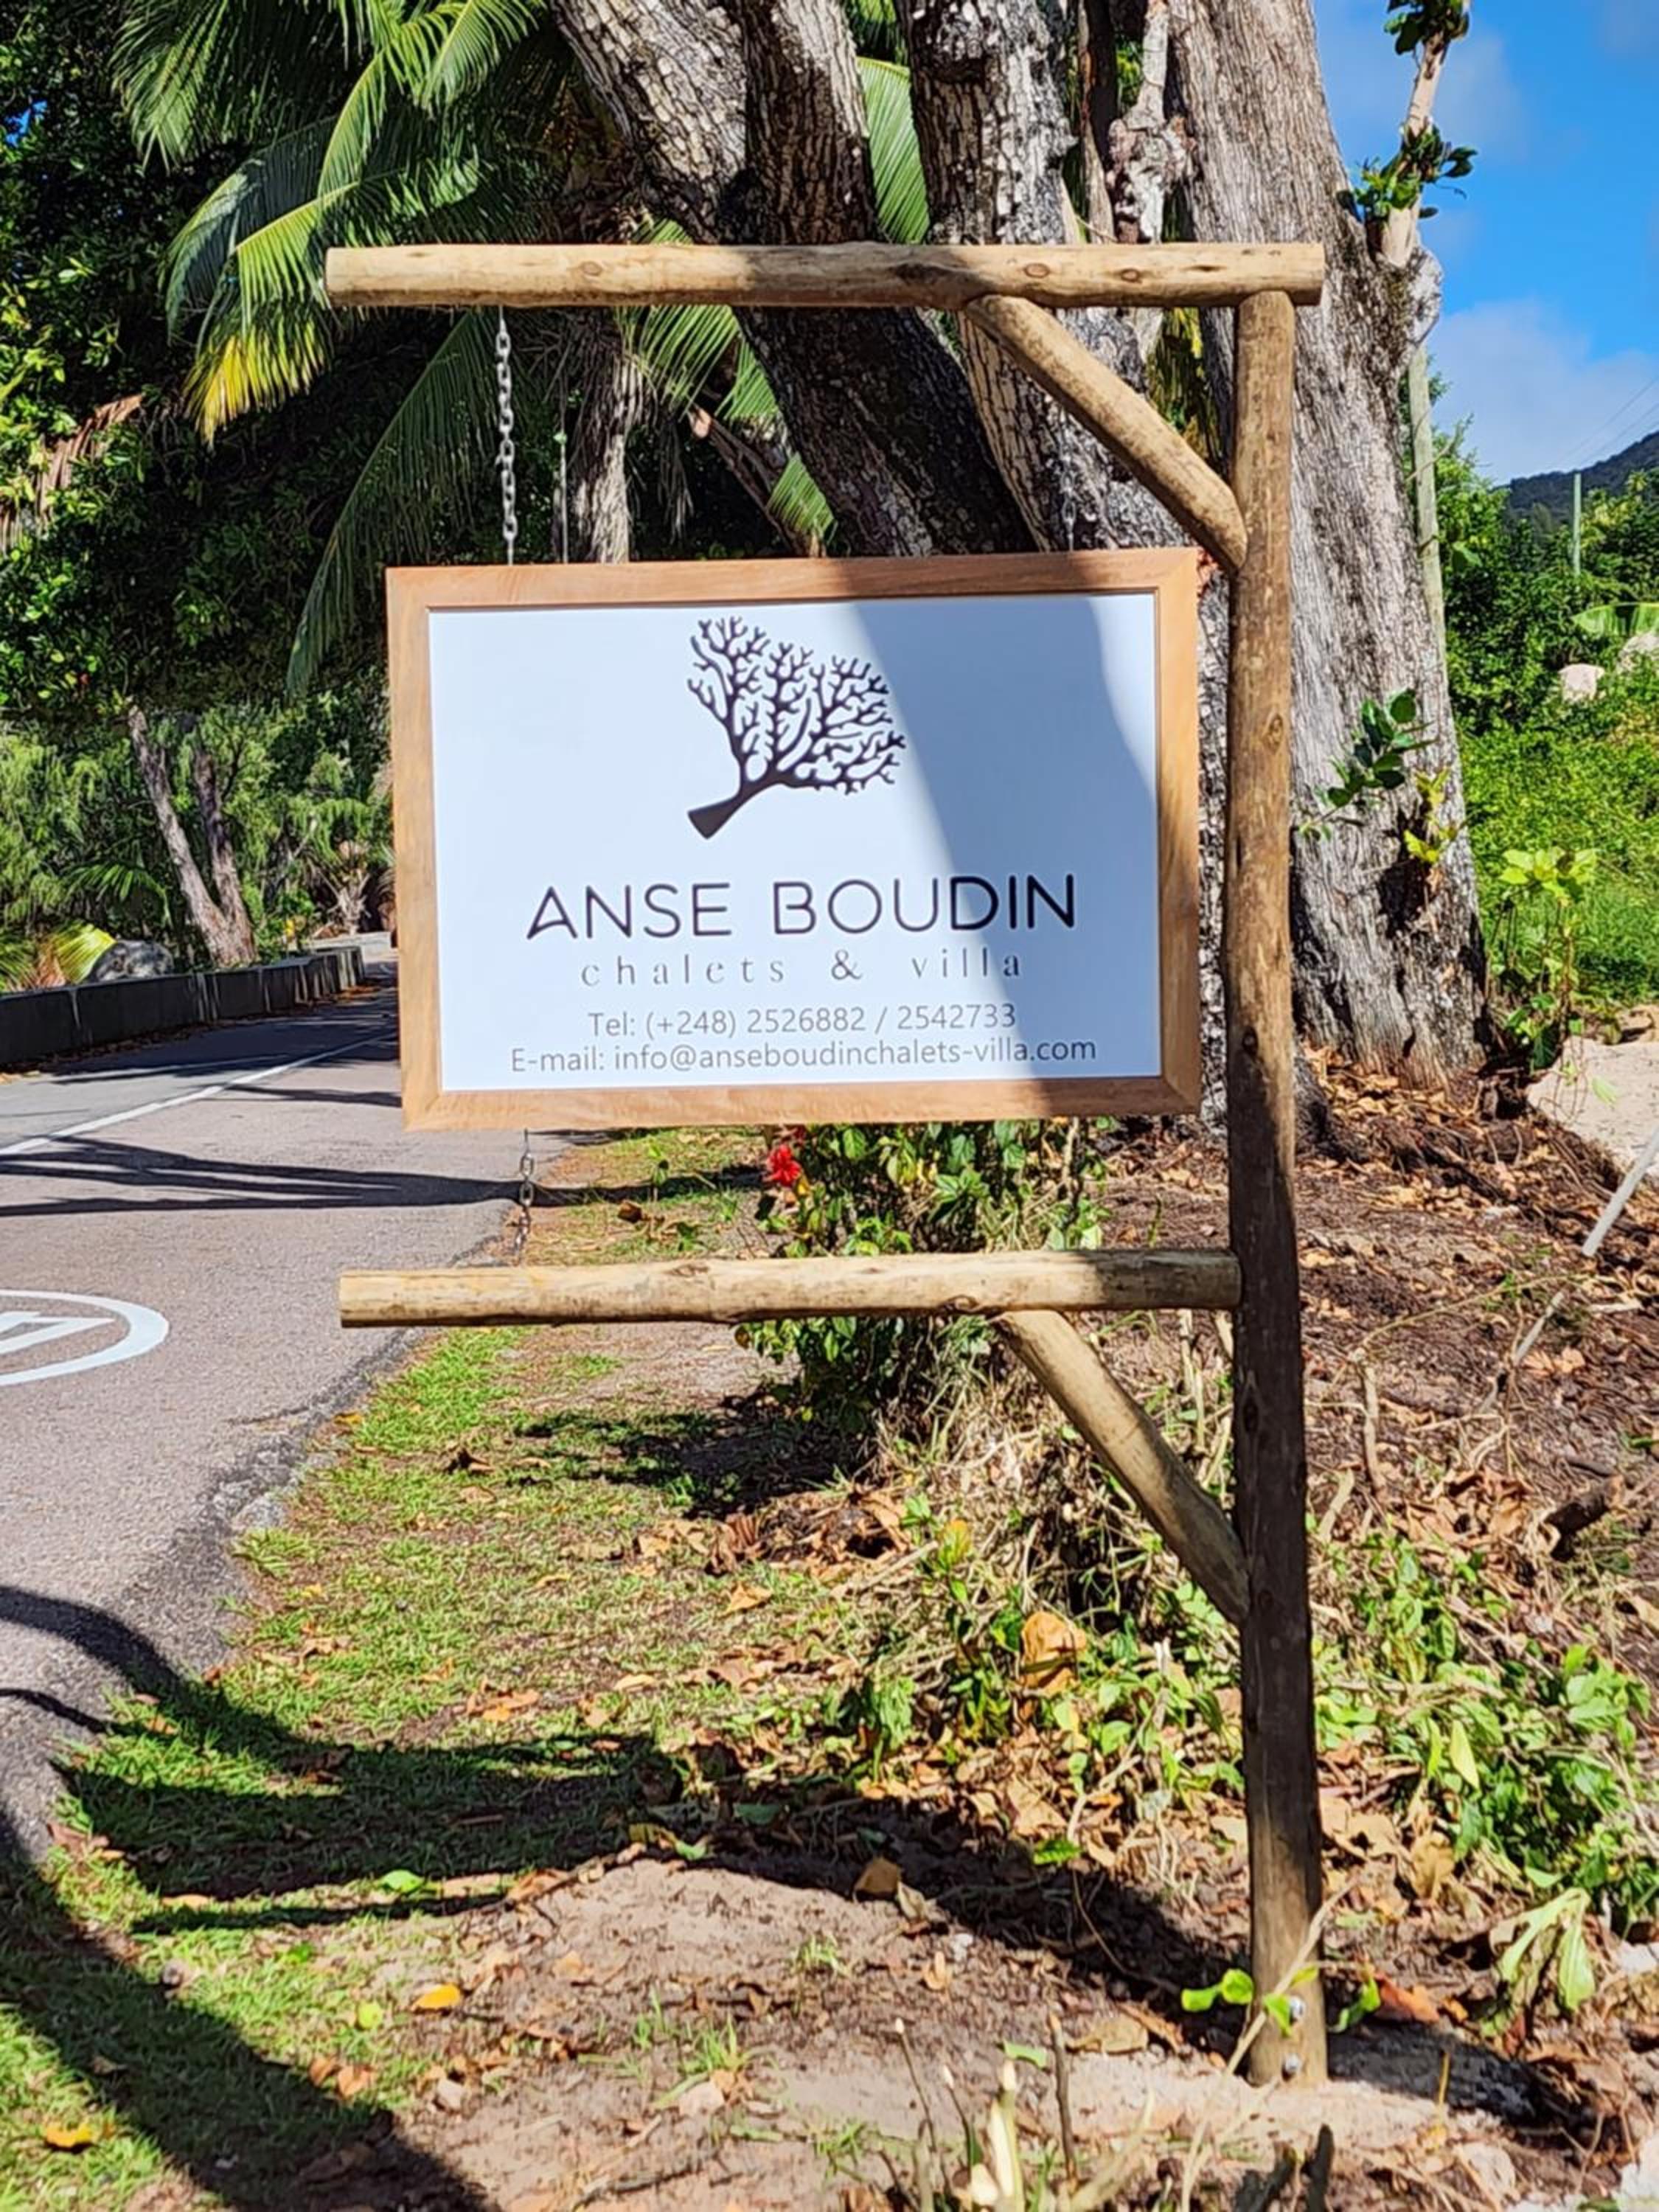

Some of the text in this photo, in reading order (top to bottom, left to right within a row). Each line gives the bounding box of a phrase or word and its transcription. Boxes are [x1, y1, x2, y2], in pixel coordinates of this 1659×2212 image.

[526, 874, 1075, 939] ANSE BOUDIN
[581, 947, 1020, 986] chalets & villa
[588, 1004, 1015, 1039] Tel: (+248) 2526882 / 2542733
[512, 1037, 1096, 1071] E-mail: info@anseboudinchalets-villa.com
